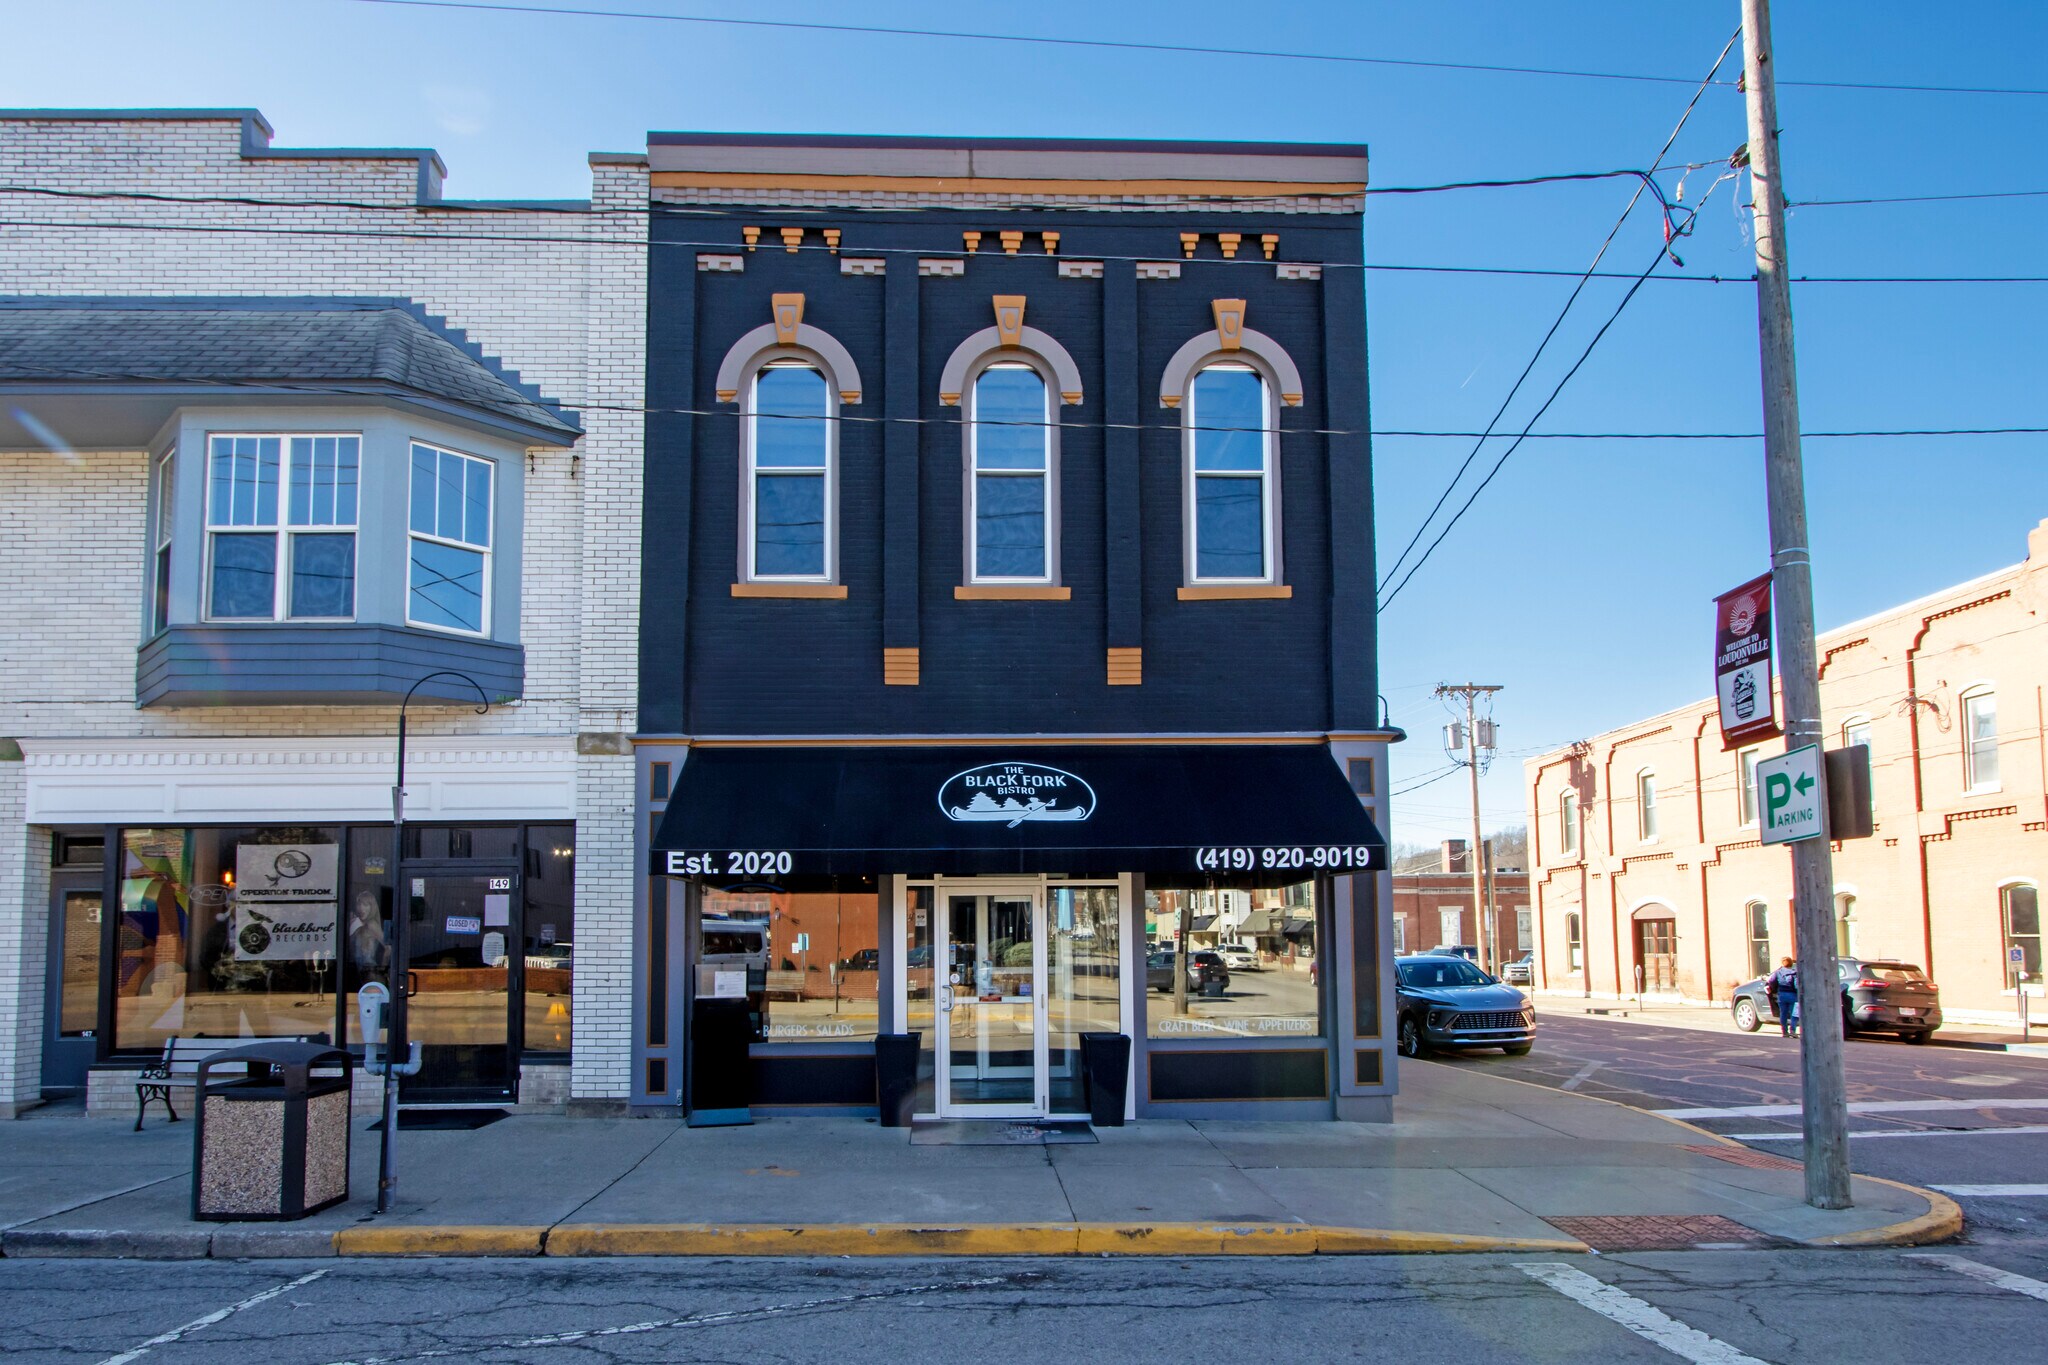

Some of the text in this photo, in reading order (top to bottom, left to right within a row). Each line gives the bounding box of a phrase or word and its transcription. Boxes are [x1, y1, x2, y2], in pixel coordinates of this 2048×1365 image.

[1726, 633, 1760, 652] WELCOME TO
[1718, 638, 1769, 667] LOUDONVILLE
[1004, 766, 1024, 775] THE
[965, 775, 1067, 787] BLACK FORK
[997, 786, 1036, 795] BISTRO
[667, 851, 792, 875] Est. 2020
[1195, 847, 1370, 871] (419) 920-9019
[490, 879, 509, 889] 149
[272, 922, 335, 934] blackbird
[448, 919, 469, 928] CLOSED
[276, 933, 328, 943] RECORDS
[763, 1024, 855, 1037] BURGERS SALADS
[1158, 1018, 1312, 1033] CRAFT BEER WINE APPETIZERS
